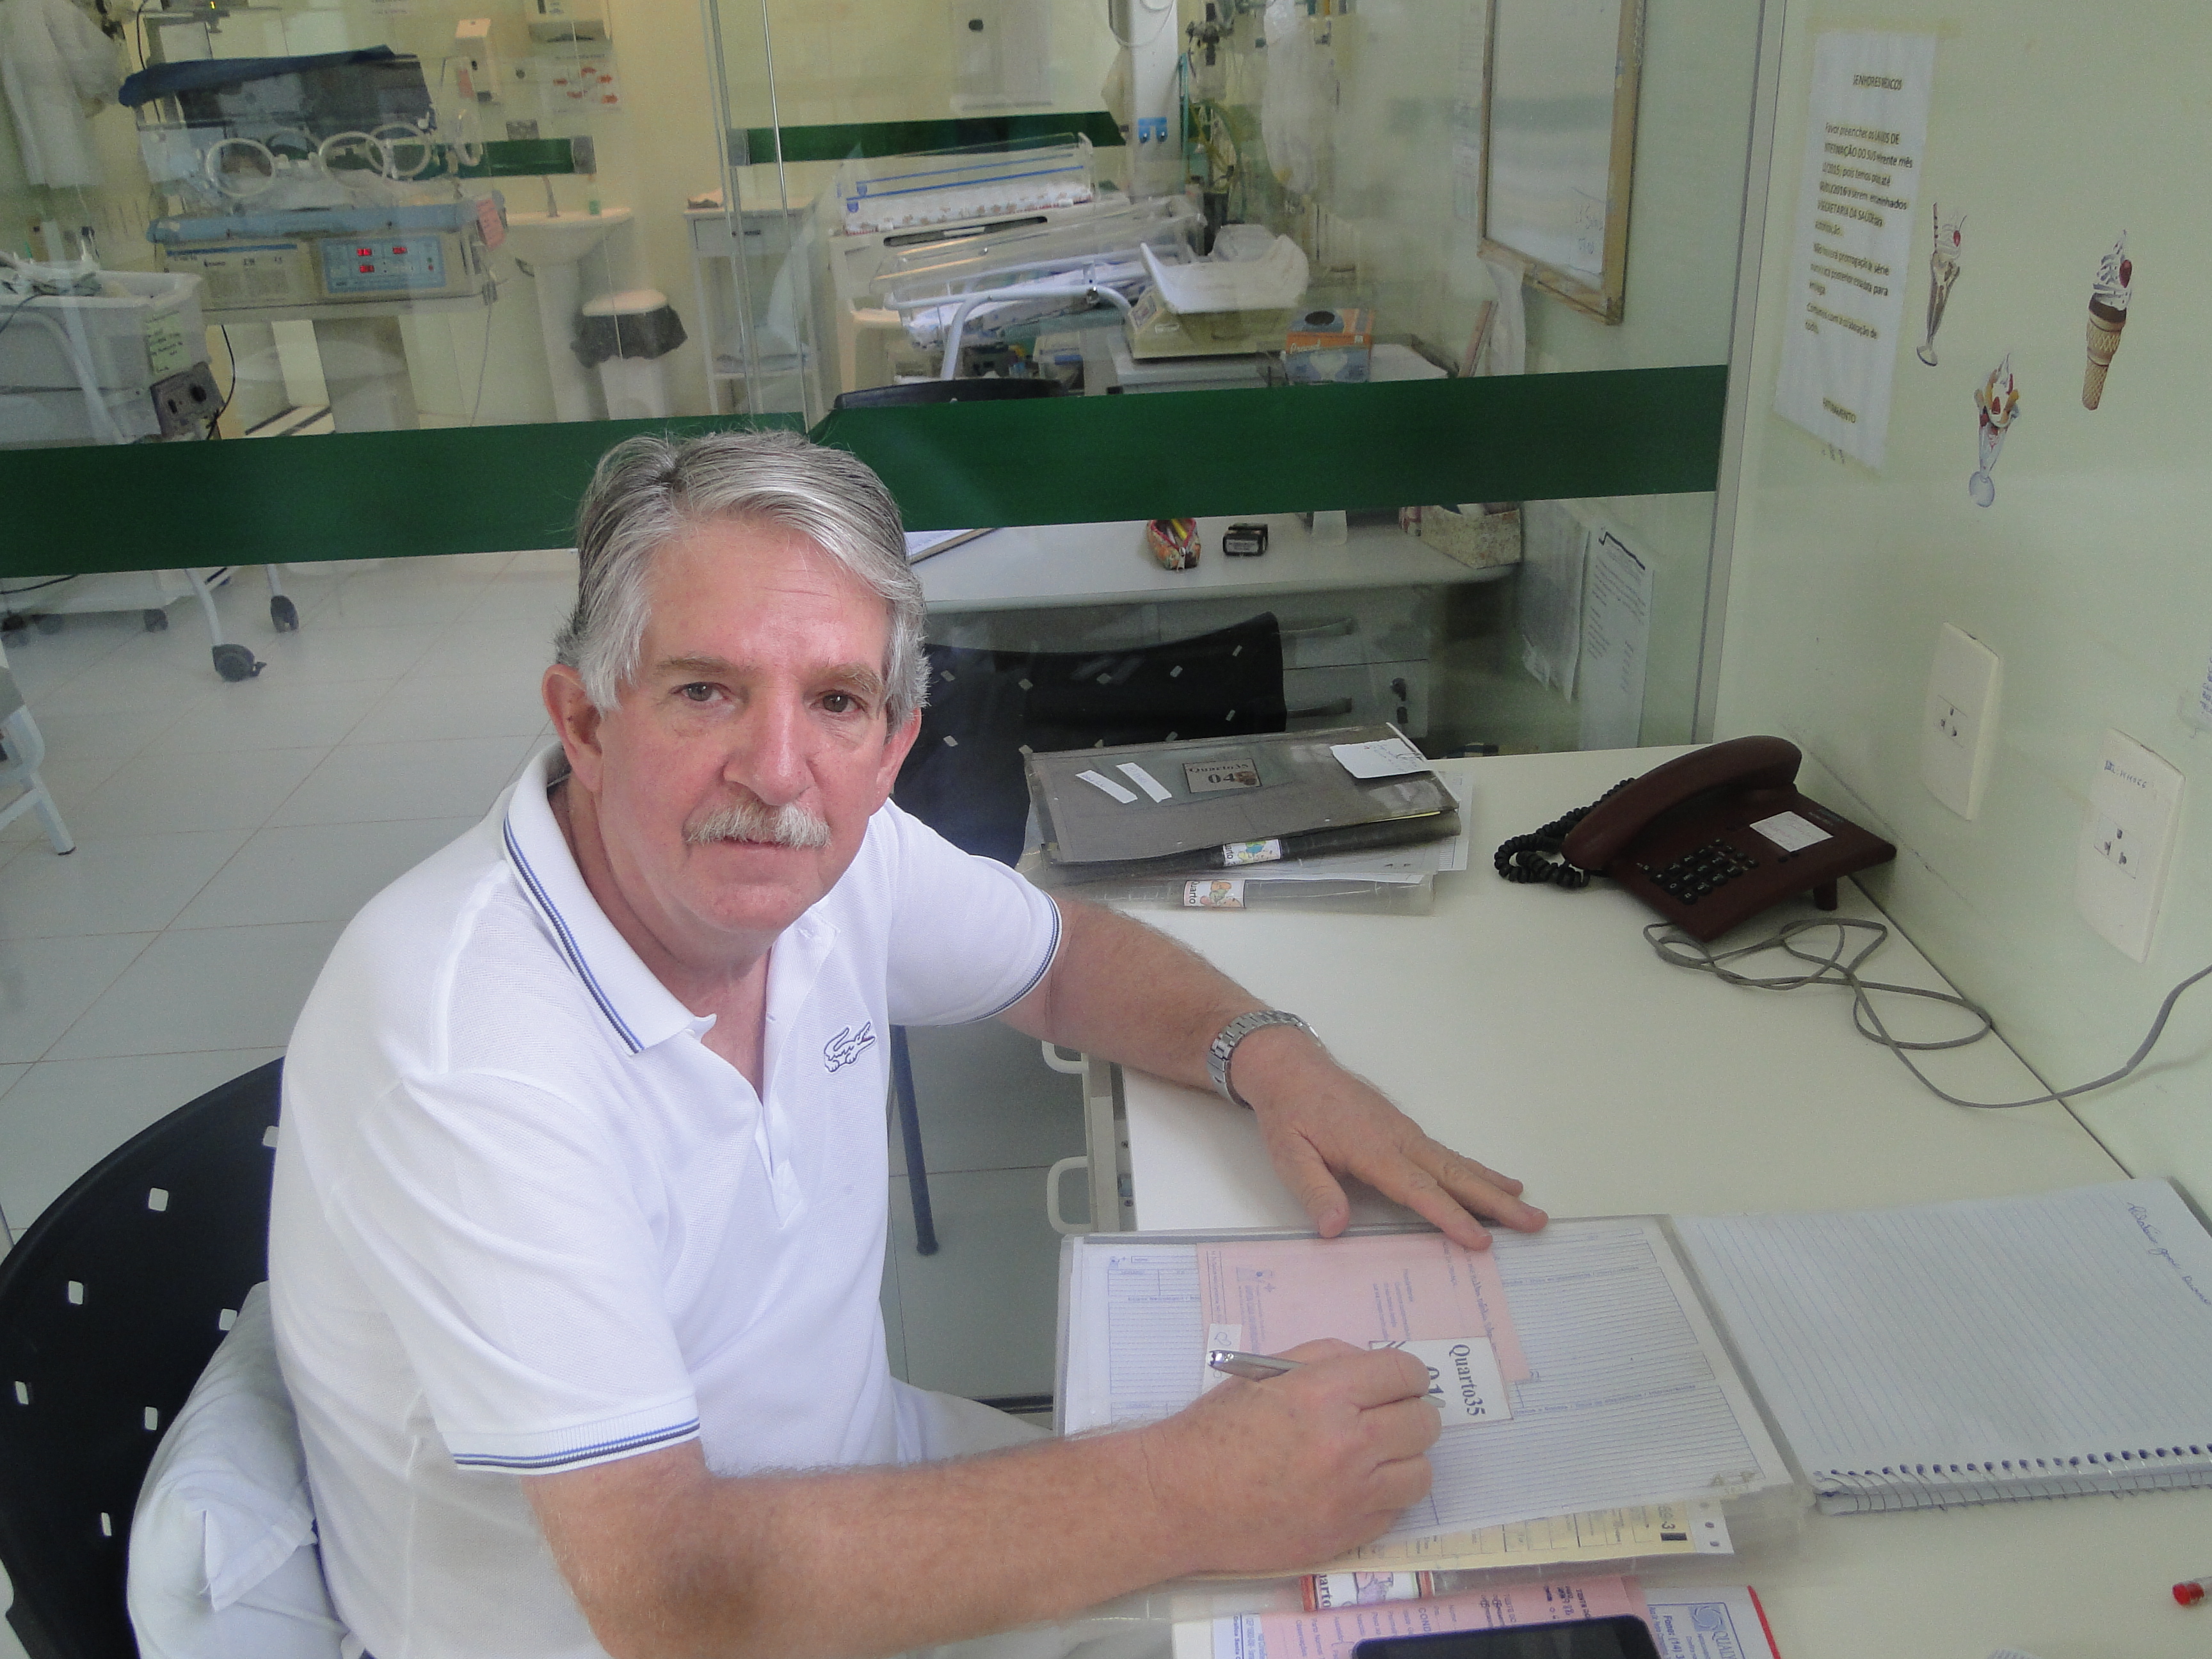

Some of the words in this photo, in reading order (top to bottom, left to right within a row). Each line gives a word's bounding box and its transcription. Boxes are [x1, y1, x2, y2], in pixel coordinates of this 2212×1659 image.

[1889, 132, 1900, 147] DE
[1898, 154, 1913, 170] mês
[1872, 283, 1888, 300] para
[1448, 1344, 1486, 1416] Quarto35
[1663, 1615, 1676, 1636] Fone:
[1295, 1619, 1308, 1657] Observações
[1668, 1637, 1683, 1653] (14)
